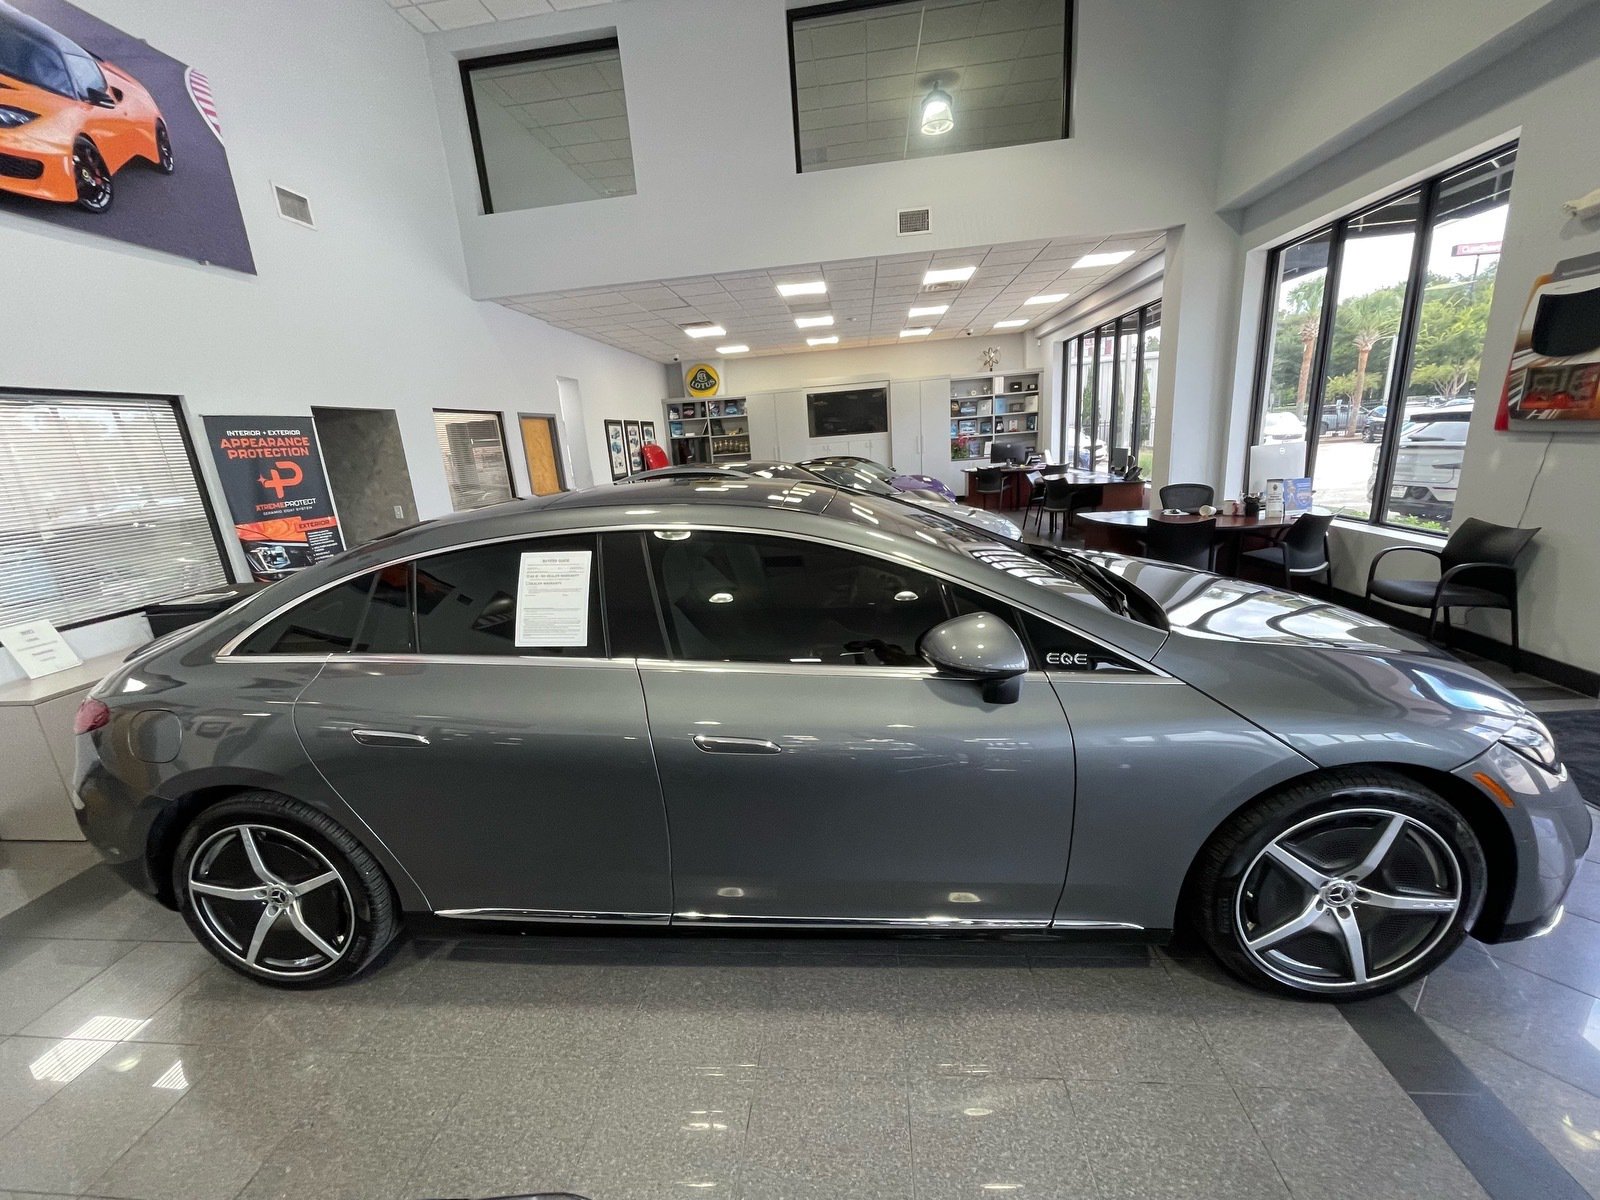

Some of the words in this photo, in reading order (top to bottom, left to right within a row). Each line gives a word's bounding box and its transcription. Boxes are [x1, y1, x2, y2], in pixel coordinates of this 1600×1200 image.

[691, 379, 716, 389] LOTUS
[220, 437, 310, 449] APPEARANCE
[227, 447, 309, 459] PROTECTION
[299, 520, 330, 529] EXTERIOR
[1046, 652, 1088, 665] EQE
